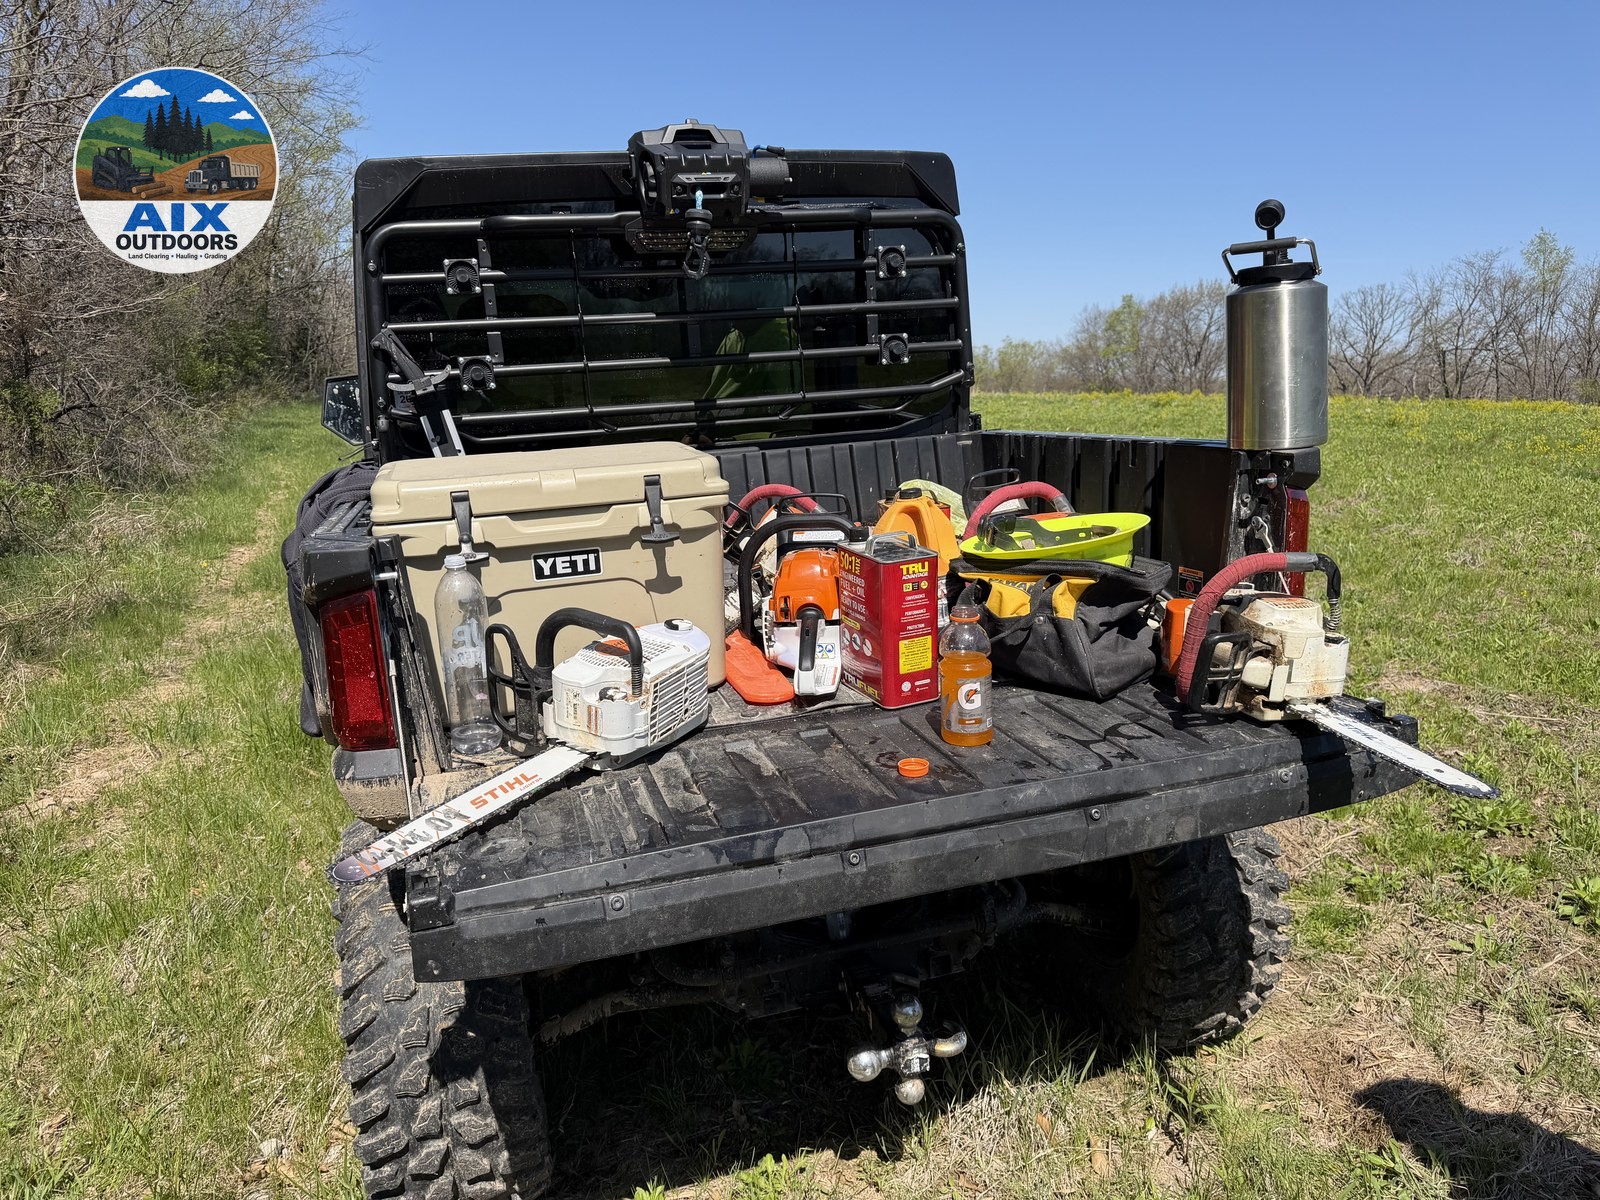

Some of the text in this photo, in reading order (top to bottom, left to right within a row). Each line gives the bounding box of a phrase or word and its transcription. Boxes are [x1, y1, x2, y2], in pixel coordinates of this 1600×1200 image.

[536, 553, 596, 576] YETI
[840, 551, 855, 573] 50:1
[900, 561, 929, 576] TRU
[902, 572, 929, 580] ADVANTAGE
[843, 670, 881, 701] TRUFUEL
[957, 682, 982, 710] G
[470, 772, 539, 810] STIHL
